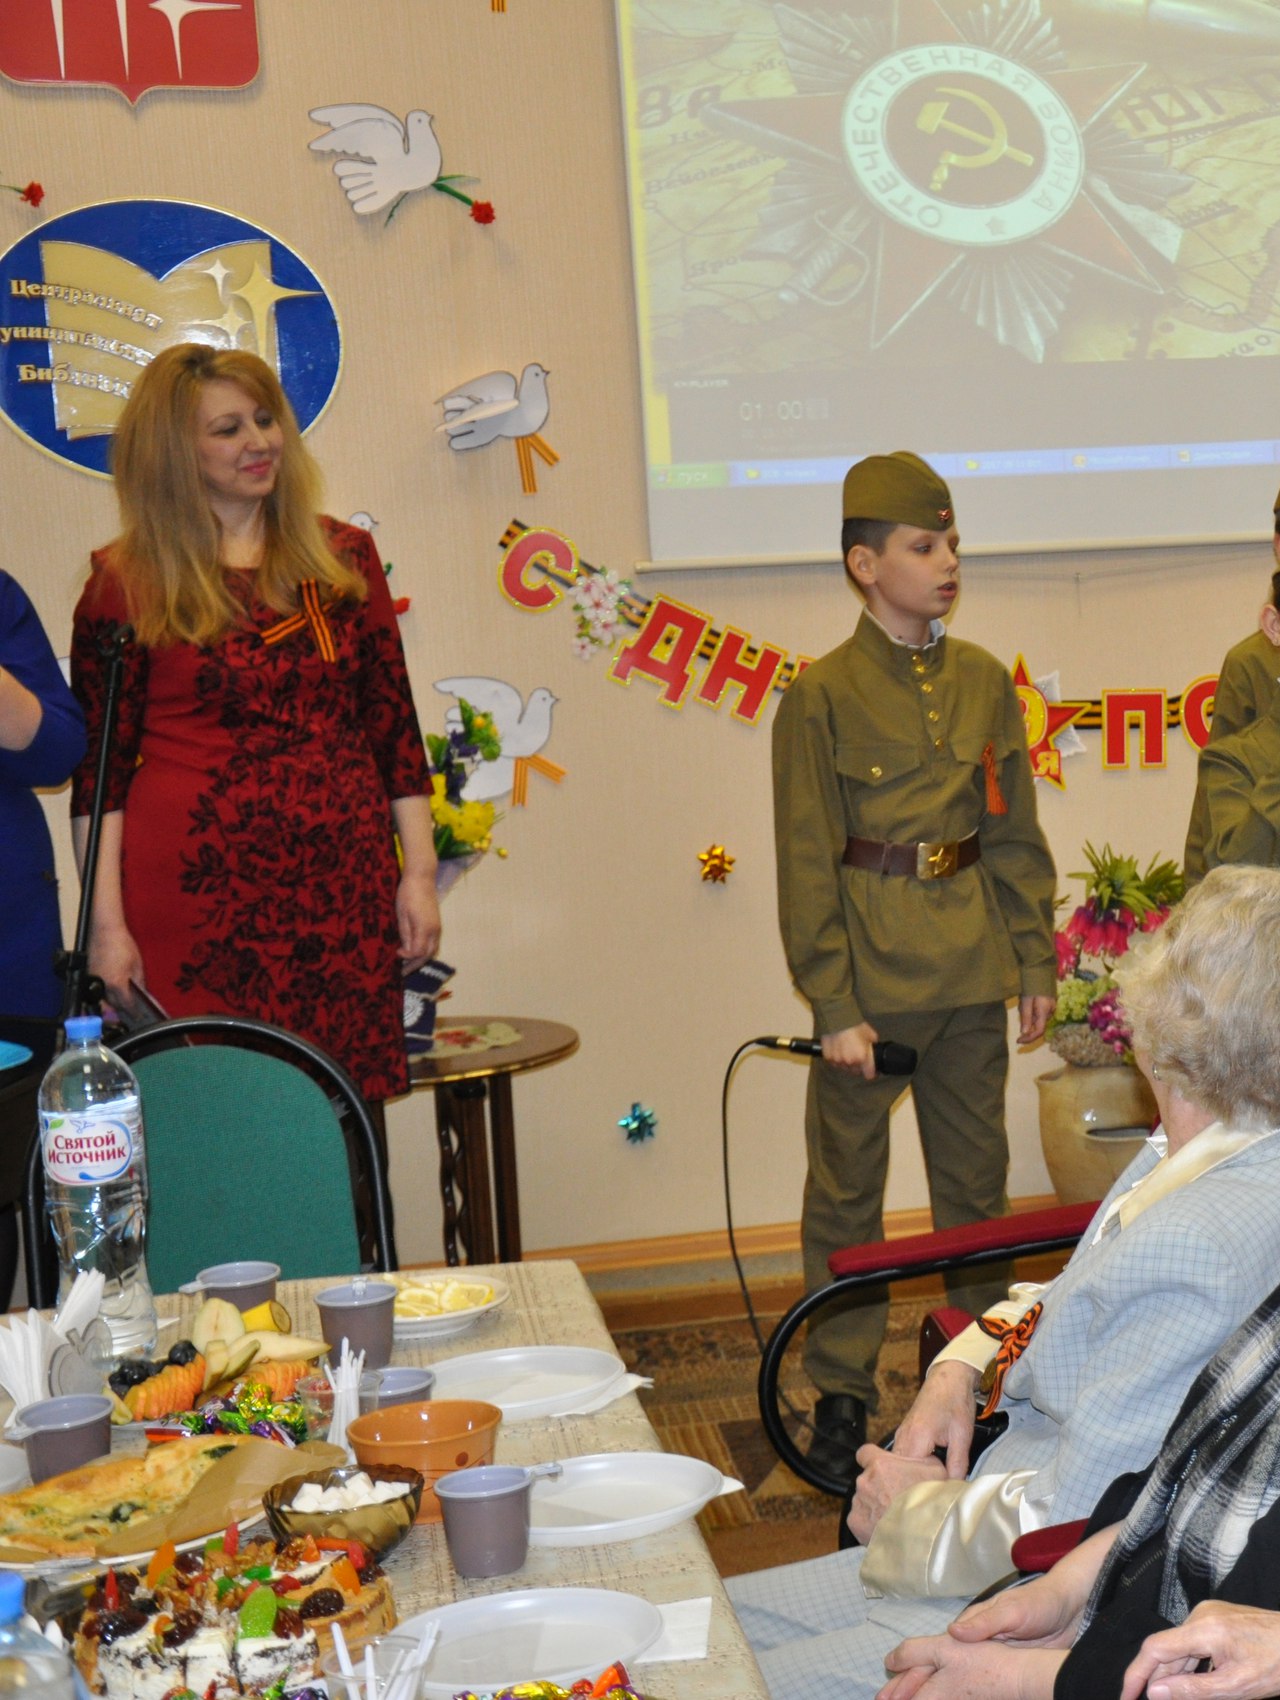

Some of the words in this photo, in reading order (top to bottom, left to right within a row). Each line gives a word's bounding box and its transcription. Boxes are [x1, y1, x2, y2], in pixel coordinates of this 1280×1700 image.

[852, 48, 1033, 228] ОТЕЧЕСТВЕННАЯ
[1031, 101, 1077, 212] ВОЙНА
[9, 279, 164, 332] Центральная
[0, 326, 156, 367] униципальна
[499, 526, 579, 612] С
[607, 593, 816, 726] ДН
[48, 1146, 126, 1164] Источник
[54, 1130, 116, 1150] Святой
